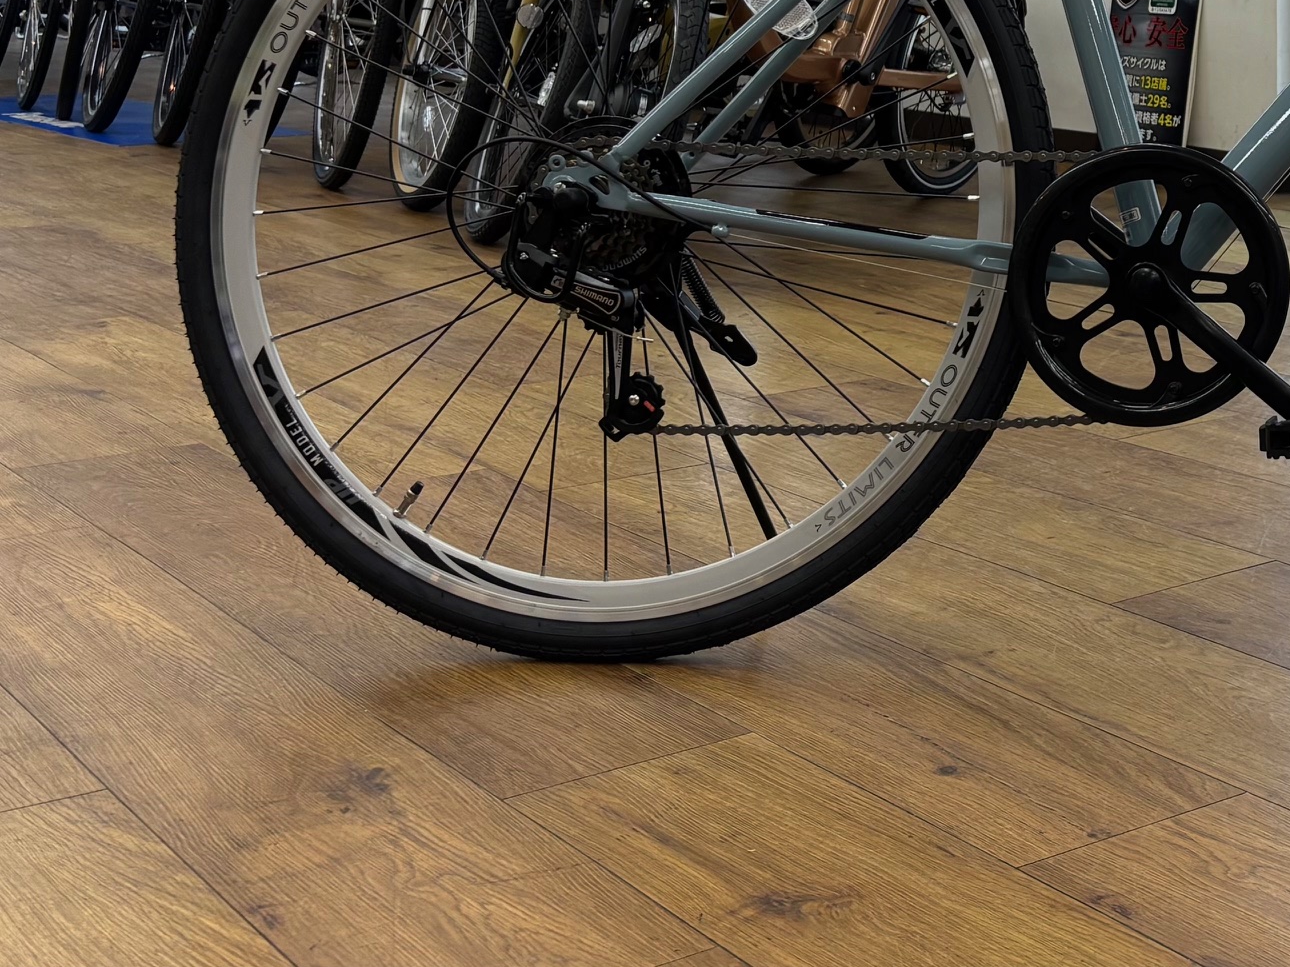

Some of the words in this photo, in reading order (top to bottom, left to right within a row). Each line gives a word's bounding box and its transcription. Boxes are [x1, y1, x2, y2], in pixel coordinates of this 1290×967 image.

[1145, 16, 1189, 50] 安全
[1129, 94, 1172, 109] 備士29名。
[574, 285, 615, 307] SHIMANO
[285, 418, 323, 467] MODEL
[823, 456, 895, 528] LIMITS
